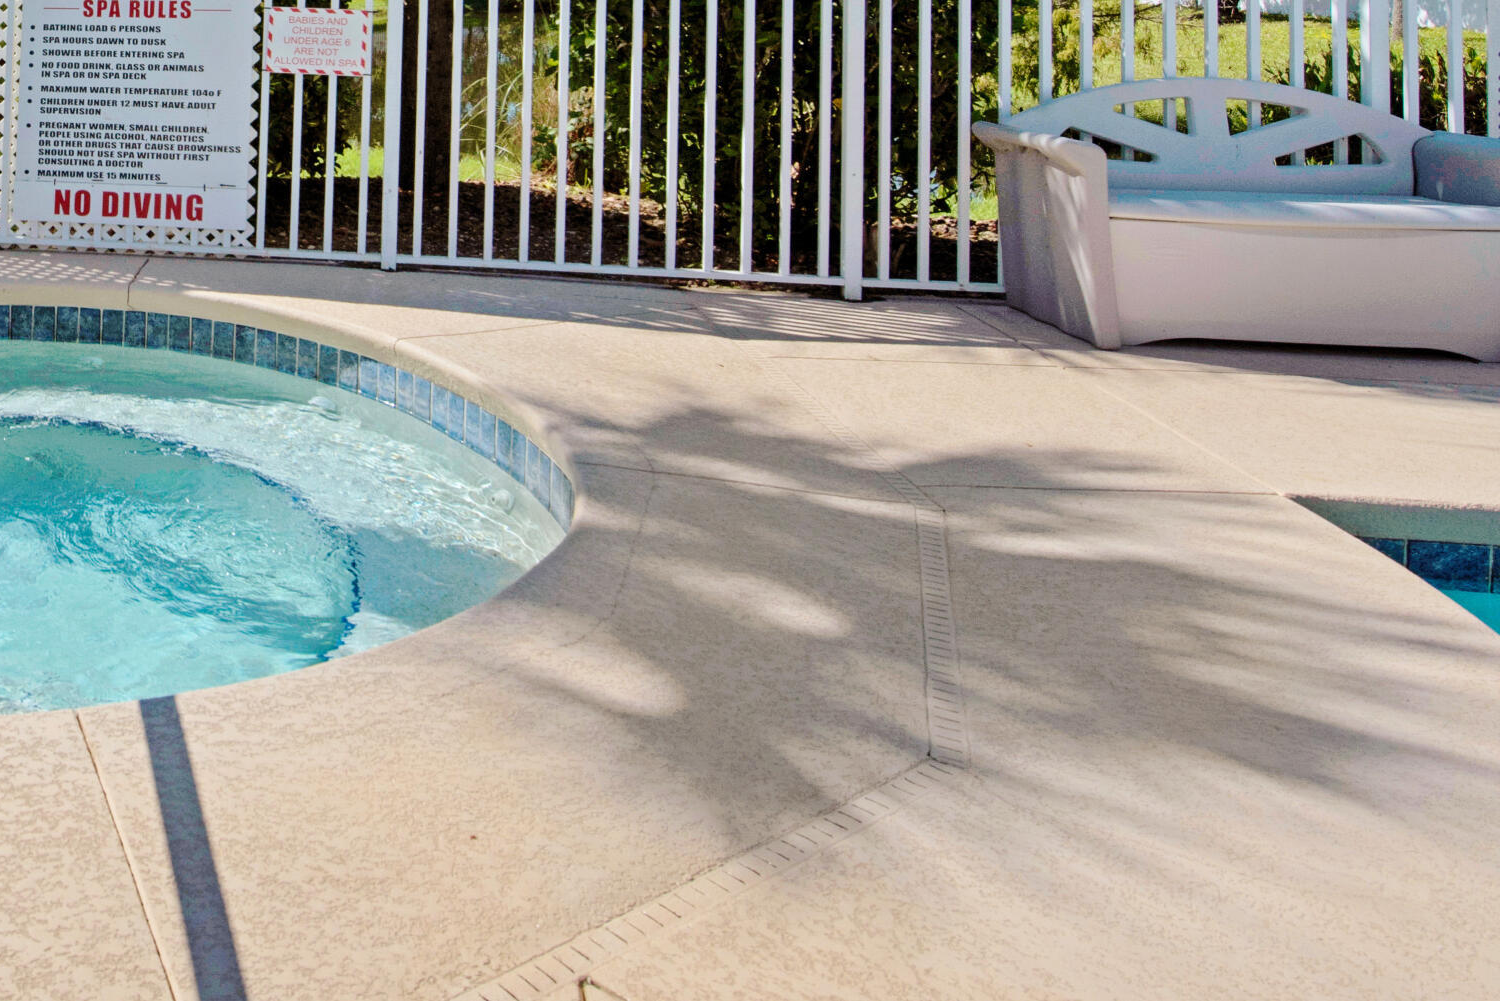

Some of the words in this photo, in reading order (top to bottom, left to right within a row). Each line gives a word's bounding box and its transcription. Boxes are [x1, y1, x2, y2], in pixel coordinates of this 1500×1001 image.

[83, 0, 121, 18] SPA
[129, 0, 192, 19] RULES
[288, 16, 324, 24] BABIES
[327, 18, 348, 26] AND
[85, 24, 108, 32] LOAD
[119, 25, 161, 33] PERSONS
[292, 26, 343, 36] CHILDREN
[42, 36, 60, 44] SPA
[284, 36, 318, 45] UNDER
[321, 37, 342, 45] AGE
[344, 38, 351, 46] 6
[42, 49, 82, 57] SHOWER
[294, 47, 314, 55] ARE
[274, 56, 320, 66] ALLOWED
[326, 58, 335, 66] IN
[339, 59, 357, 67] SPA
[116, 63, 145, 71] GLASS
[163, 64, 205, 72] ANIMALS
[41, 85, 87, 93] MAXIMUM
[90, 86, 121, 94] WATER
[124, 87, 188, 96] TEMPERATURE
[217, 89, 222, 97] F
[40, 98, 85, 106] CHILDREN
[87, 99, 118, 107] UNDER
[133, 100, 159, 108] MUST
[162, 101, 185, 109] HAVE
[187, 102, 216, 110] ADULT
[40, 107, 101, 115] SUPERVISION
[39, 122, 87, 130] PREGNANT
[129, 124, 158, 132] SMALL
[73, 131, 102, 139] USING
[150, 134, 204, 142] NARCOTICS
[53, 140, 83, 148] OTHER
[85, 141, 117, 149] DRUGS
[120, 142, 142, 150] THAT
[145, 143, 175, 151] CAUSE
[177, 144, 241, 153] DROWSINESS
[117, 151, 134, 159] SPA
[137, 152, 181, 160] WITHOUT
[183, 153, 210, 161] FIRST
[38, 157, 95, 166] CONSULTING
[97, 159, 103, 167] A
[106, 160, 143, 168] DOCTOR
[37, 169, 84, 178] MAXIMUM
[86, 171, 104, 179] USE
[119, 173, 161, 181] MINUTES
[54, 189, 91, 216] NO
[102, 191, 204, 221] DIVING
